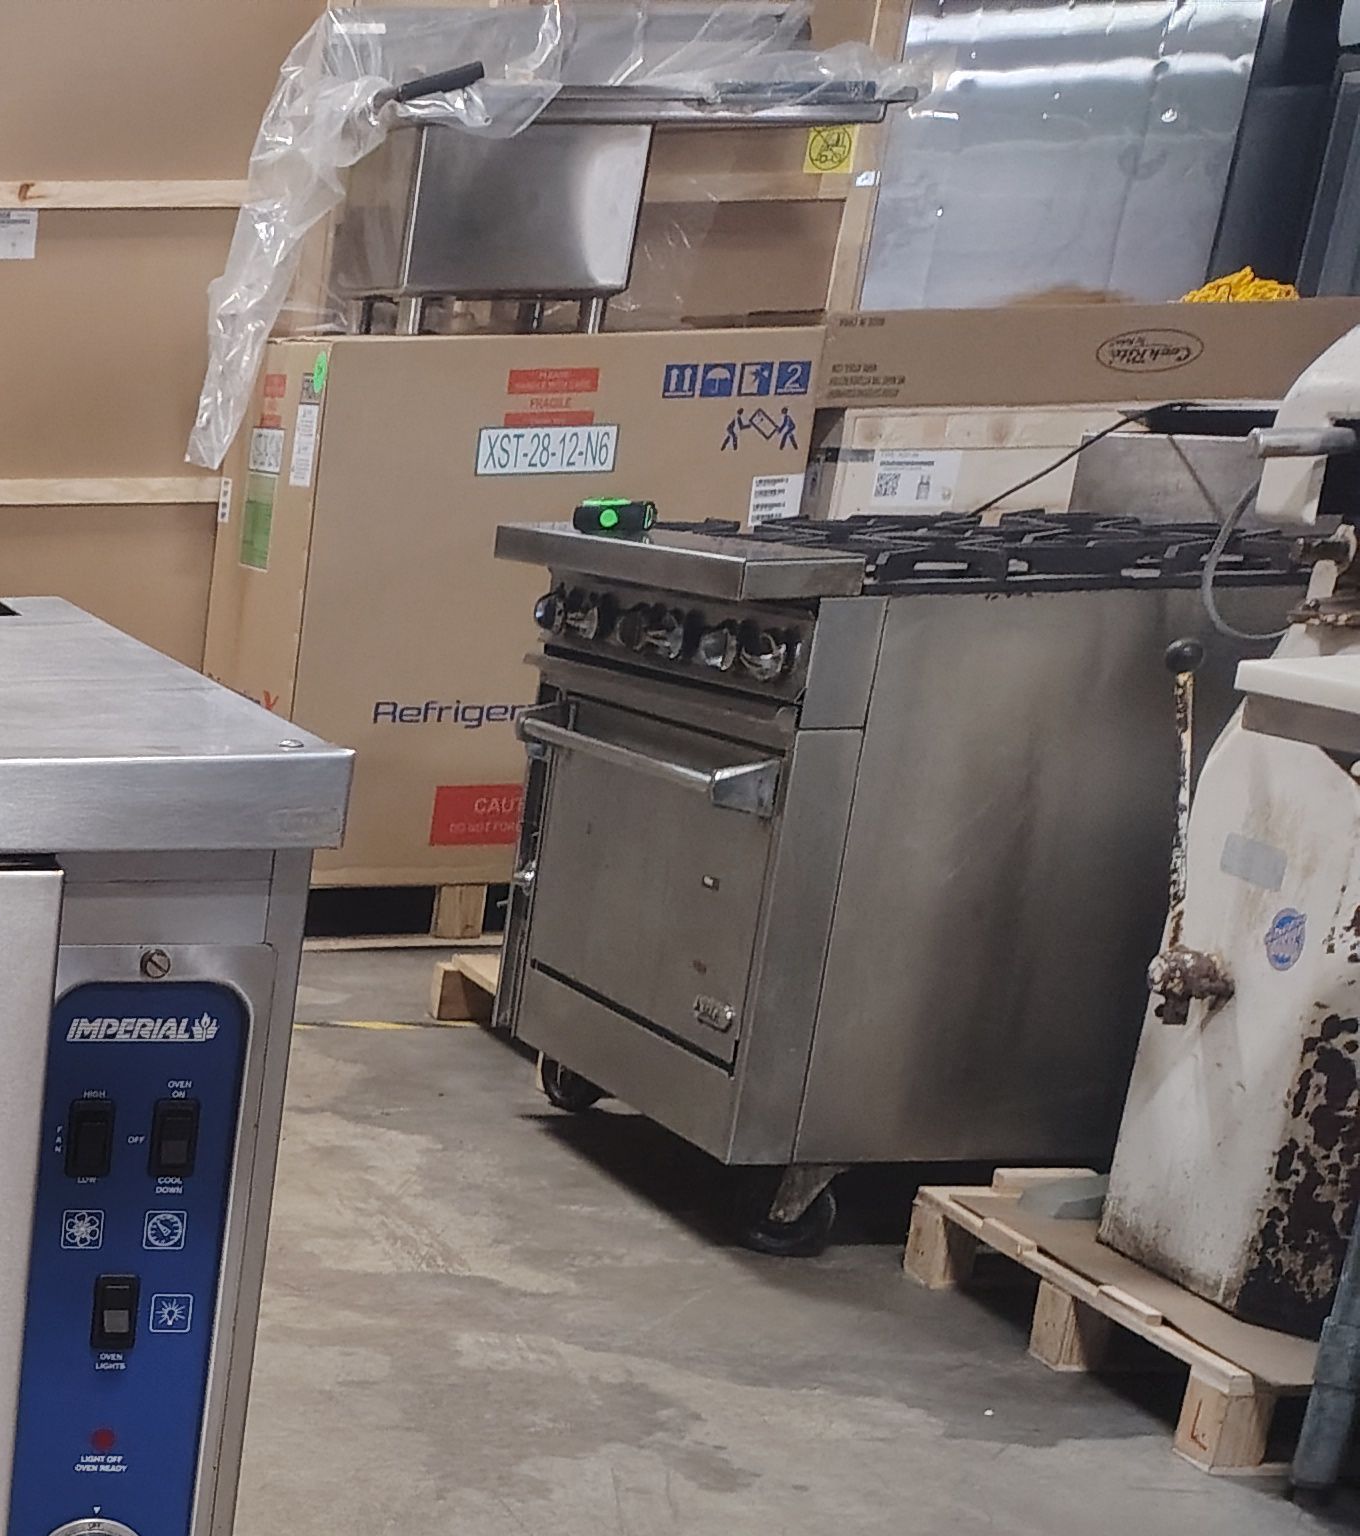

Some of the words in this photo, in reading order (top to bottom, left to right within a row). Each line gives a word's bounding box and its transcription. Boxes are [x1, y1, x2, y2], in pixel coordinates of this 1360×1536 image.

[483, 431, 611, 469] XST-28-12-N6
[373, 699, 539, 729] Refriger
[66, 1017, 192, 1042] IMPERIAL
[167, 1080, 192, 1088] OVEN
[83, 1090, 106, 1099] HIGH
[171, 1090, 186, 1099] ON
[127, 1135, 146, 1144] OFF
[155, 1186, 183, 1194] DOWN
[99, 1353, 123, 1361] OVEN
[95, 1362, 126, 1370] LIGHTS
[80, 1455, 105, 1463] LIGHT
[106, 1455, 123, 1463] OFF
[74, 1464, 98, 1472] OVEN
[99, 1464, 128, 1472] READY
